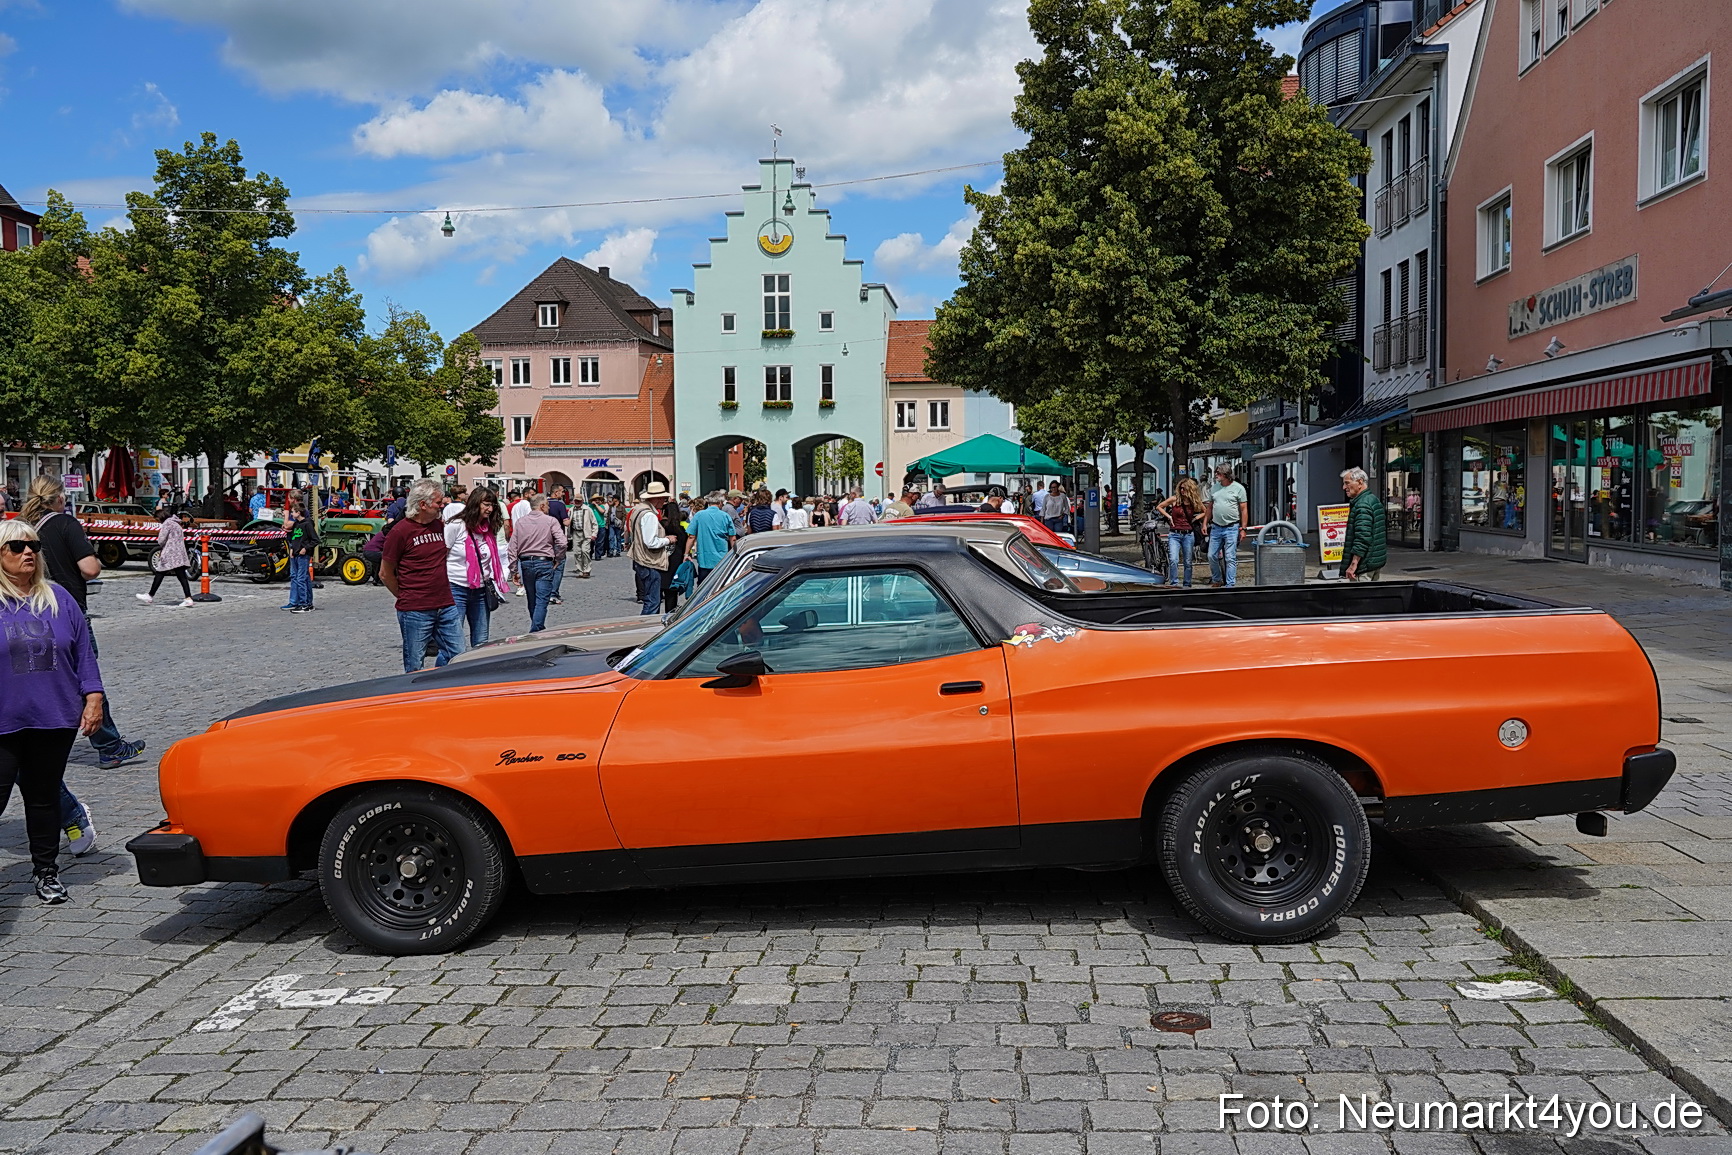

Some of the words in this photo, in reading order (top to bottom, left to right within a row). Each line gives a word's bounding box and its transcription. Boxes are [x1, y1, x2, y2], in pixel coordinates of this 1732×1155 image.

[1539, 264, 1633, 325] SCHUH-STREB
[582, 457, 610, 468] VdK
[495, 749, 544, 766] Ranchero
[556, 752, 586, 761] 500
[1193, 792, 1227, 854] RADIAL
[1230, 773, 1261, 791] G/T
[334, 825, 357, 879] COOPER
[358, 802, 402, 824] COBRA
[1321, 824, 1346, 896] COOPER
[444, 878, 474, 926] RADIAL
[1259, 897, 1320, 922] COBRA
[419, 926, 442, 941] G/T
